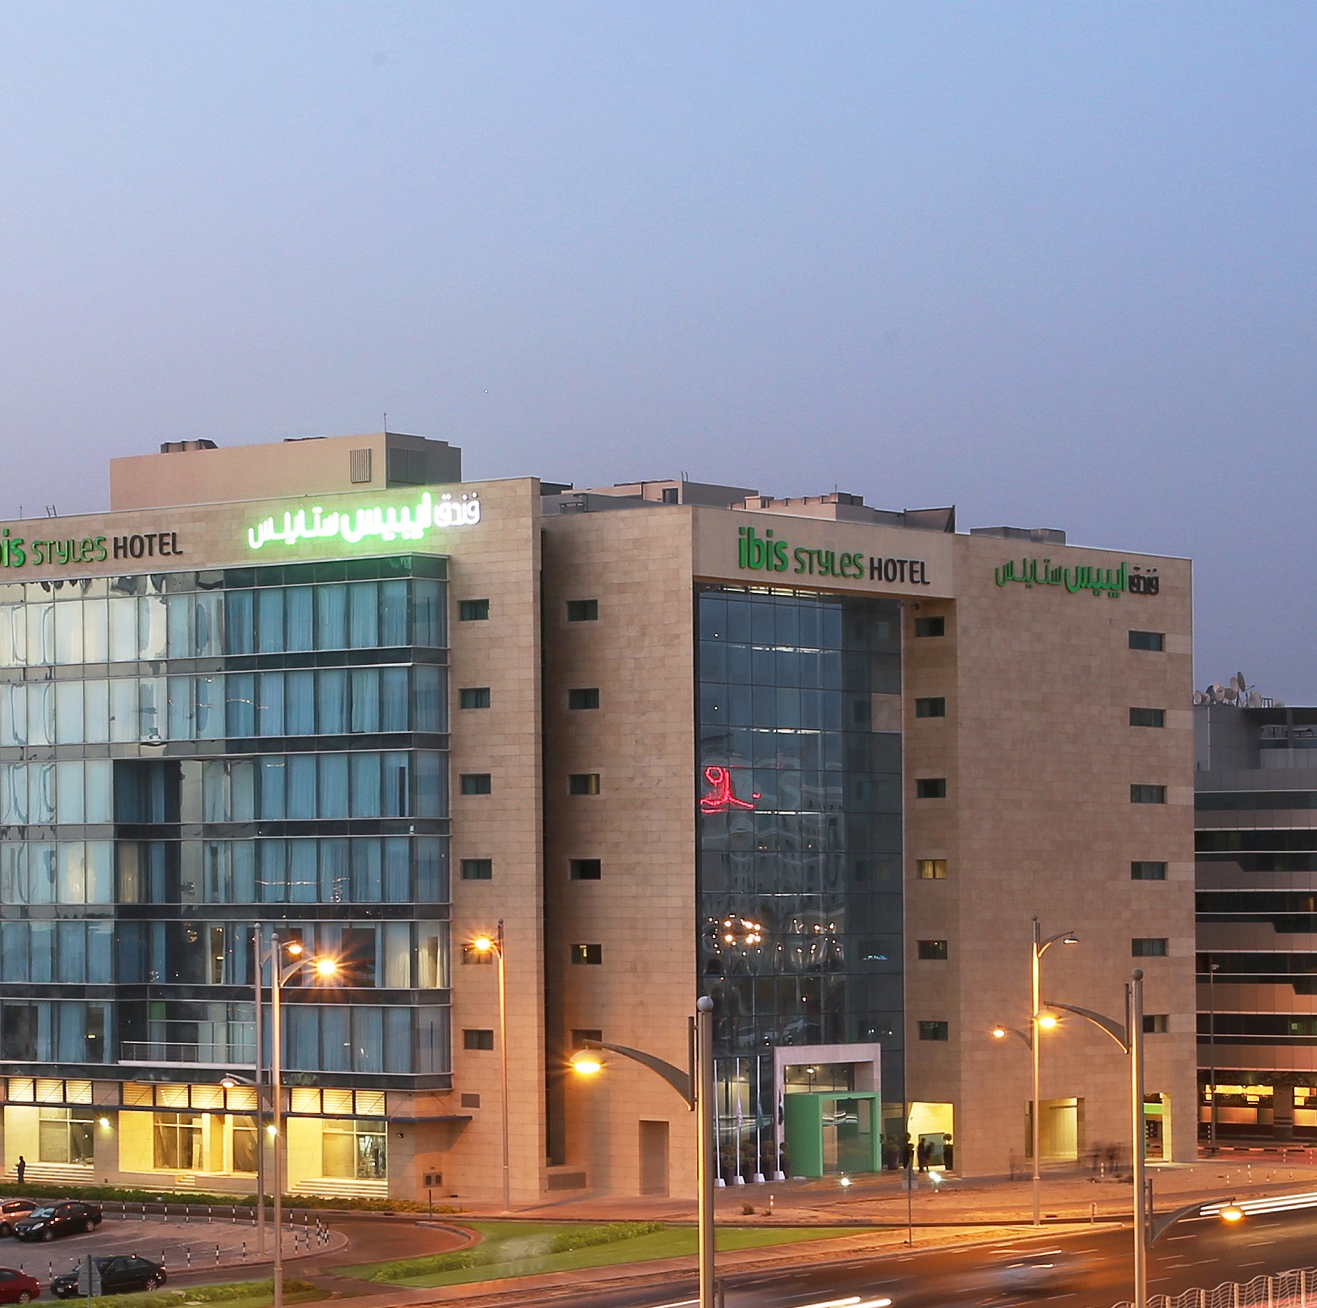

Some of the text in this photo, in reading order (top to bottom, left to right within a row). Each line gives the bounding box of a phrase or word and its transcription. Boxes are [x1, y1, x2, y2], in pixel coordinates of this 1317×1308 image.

[113, 532, 183, 559] HOTEL
[739, 527, 789, 572] ibis
[869, 557, 931, 585] HOTEL
